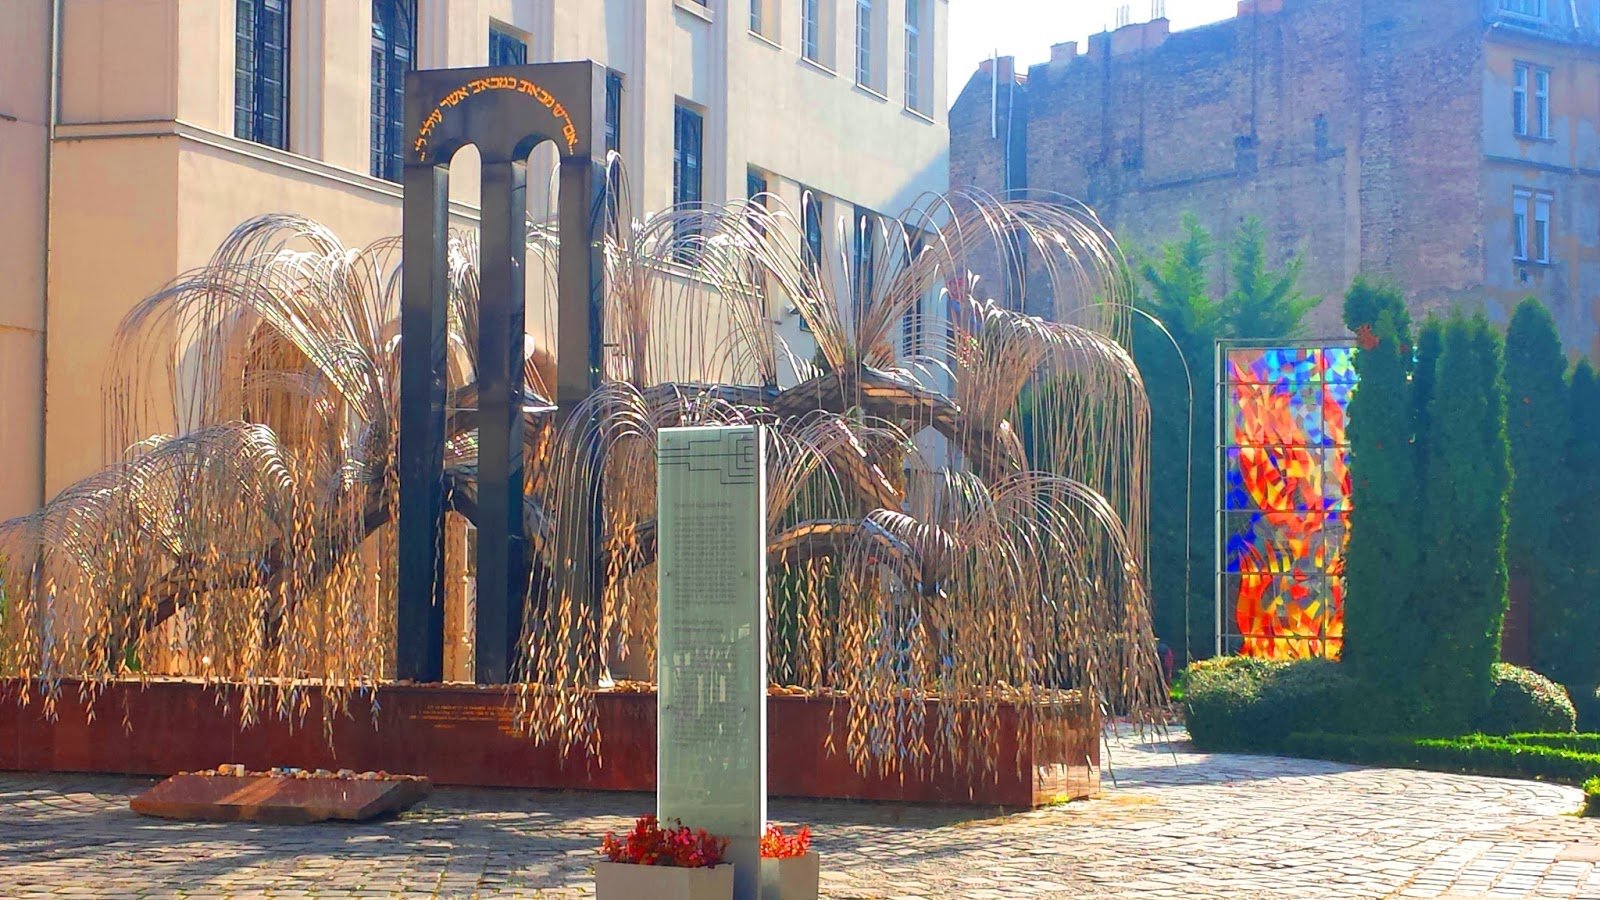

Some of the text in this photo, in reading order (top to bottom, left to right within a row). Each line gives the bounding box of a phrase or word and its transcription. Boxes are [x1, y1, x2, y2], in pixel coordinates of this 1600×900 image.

[467, 76, 516, 94] כמכאבי
[439, 86, 470, 109] אשר
[419, 108, 442, 136] עולל
